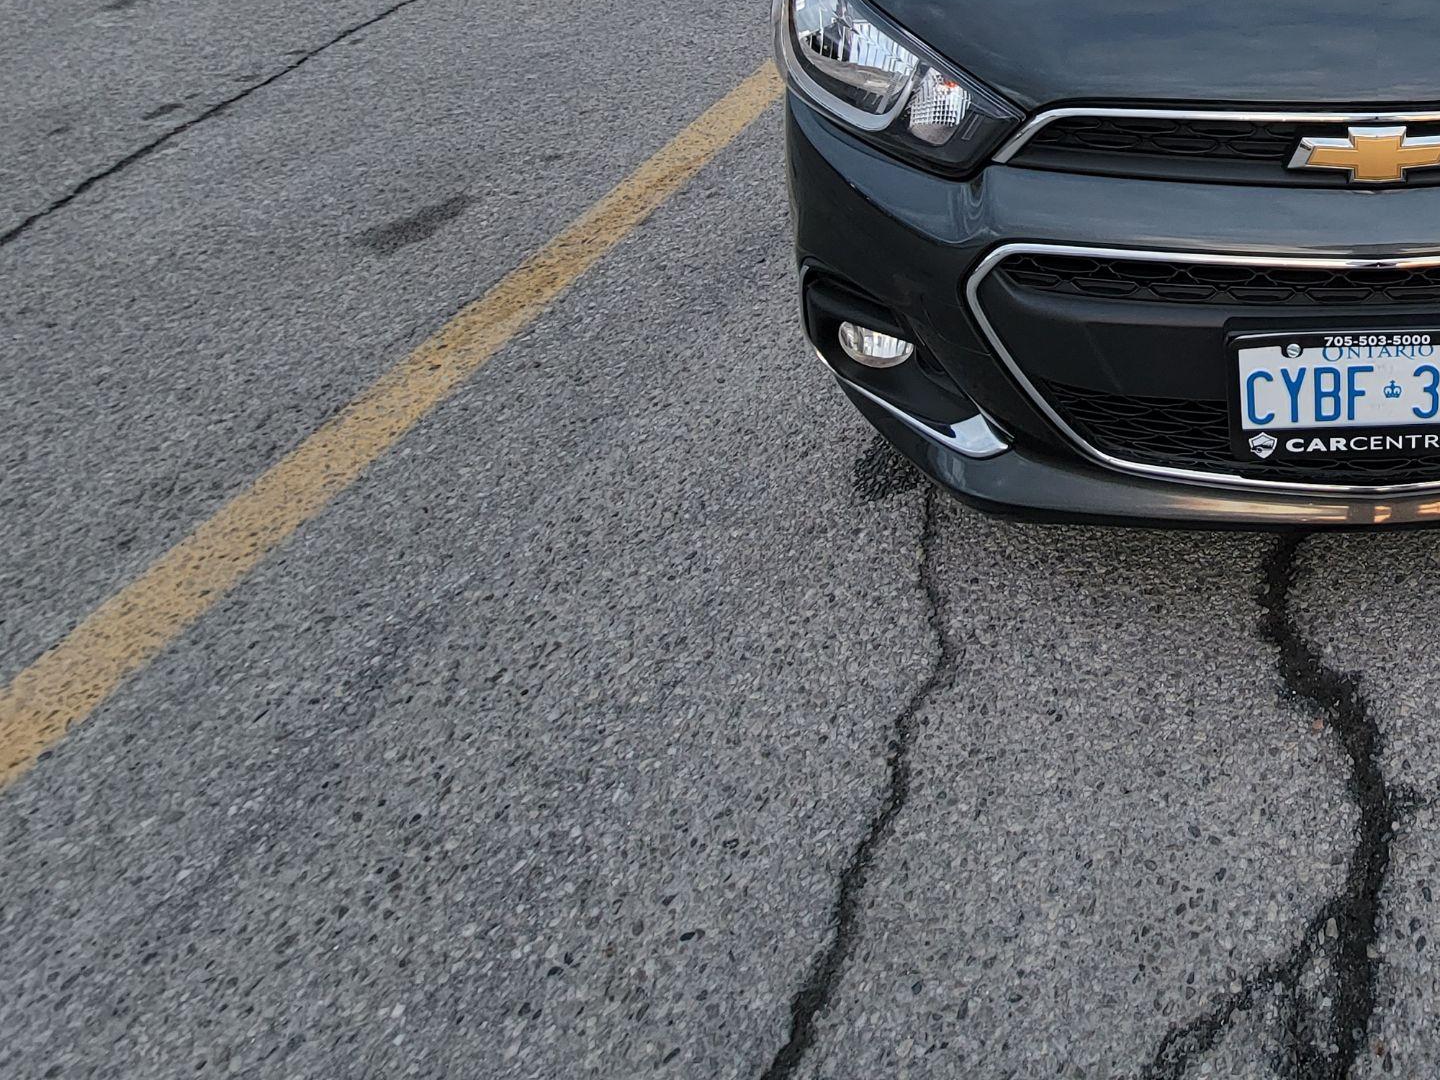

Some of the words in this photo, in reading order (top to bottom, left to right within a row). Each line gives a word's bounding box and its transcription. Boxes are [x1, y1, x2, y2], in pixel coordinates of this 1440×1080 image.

[1323, 334, 1431, 347] 705-503-5000
[1322, 344, 1434, 362] ONTARIO
[1246, 365, 1374, 426] CYBF
